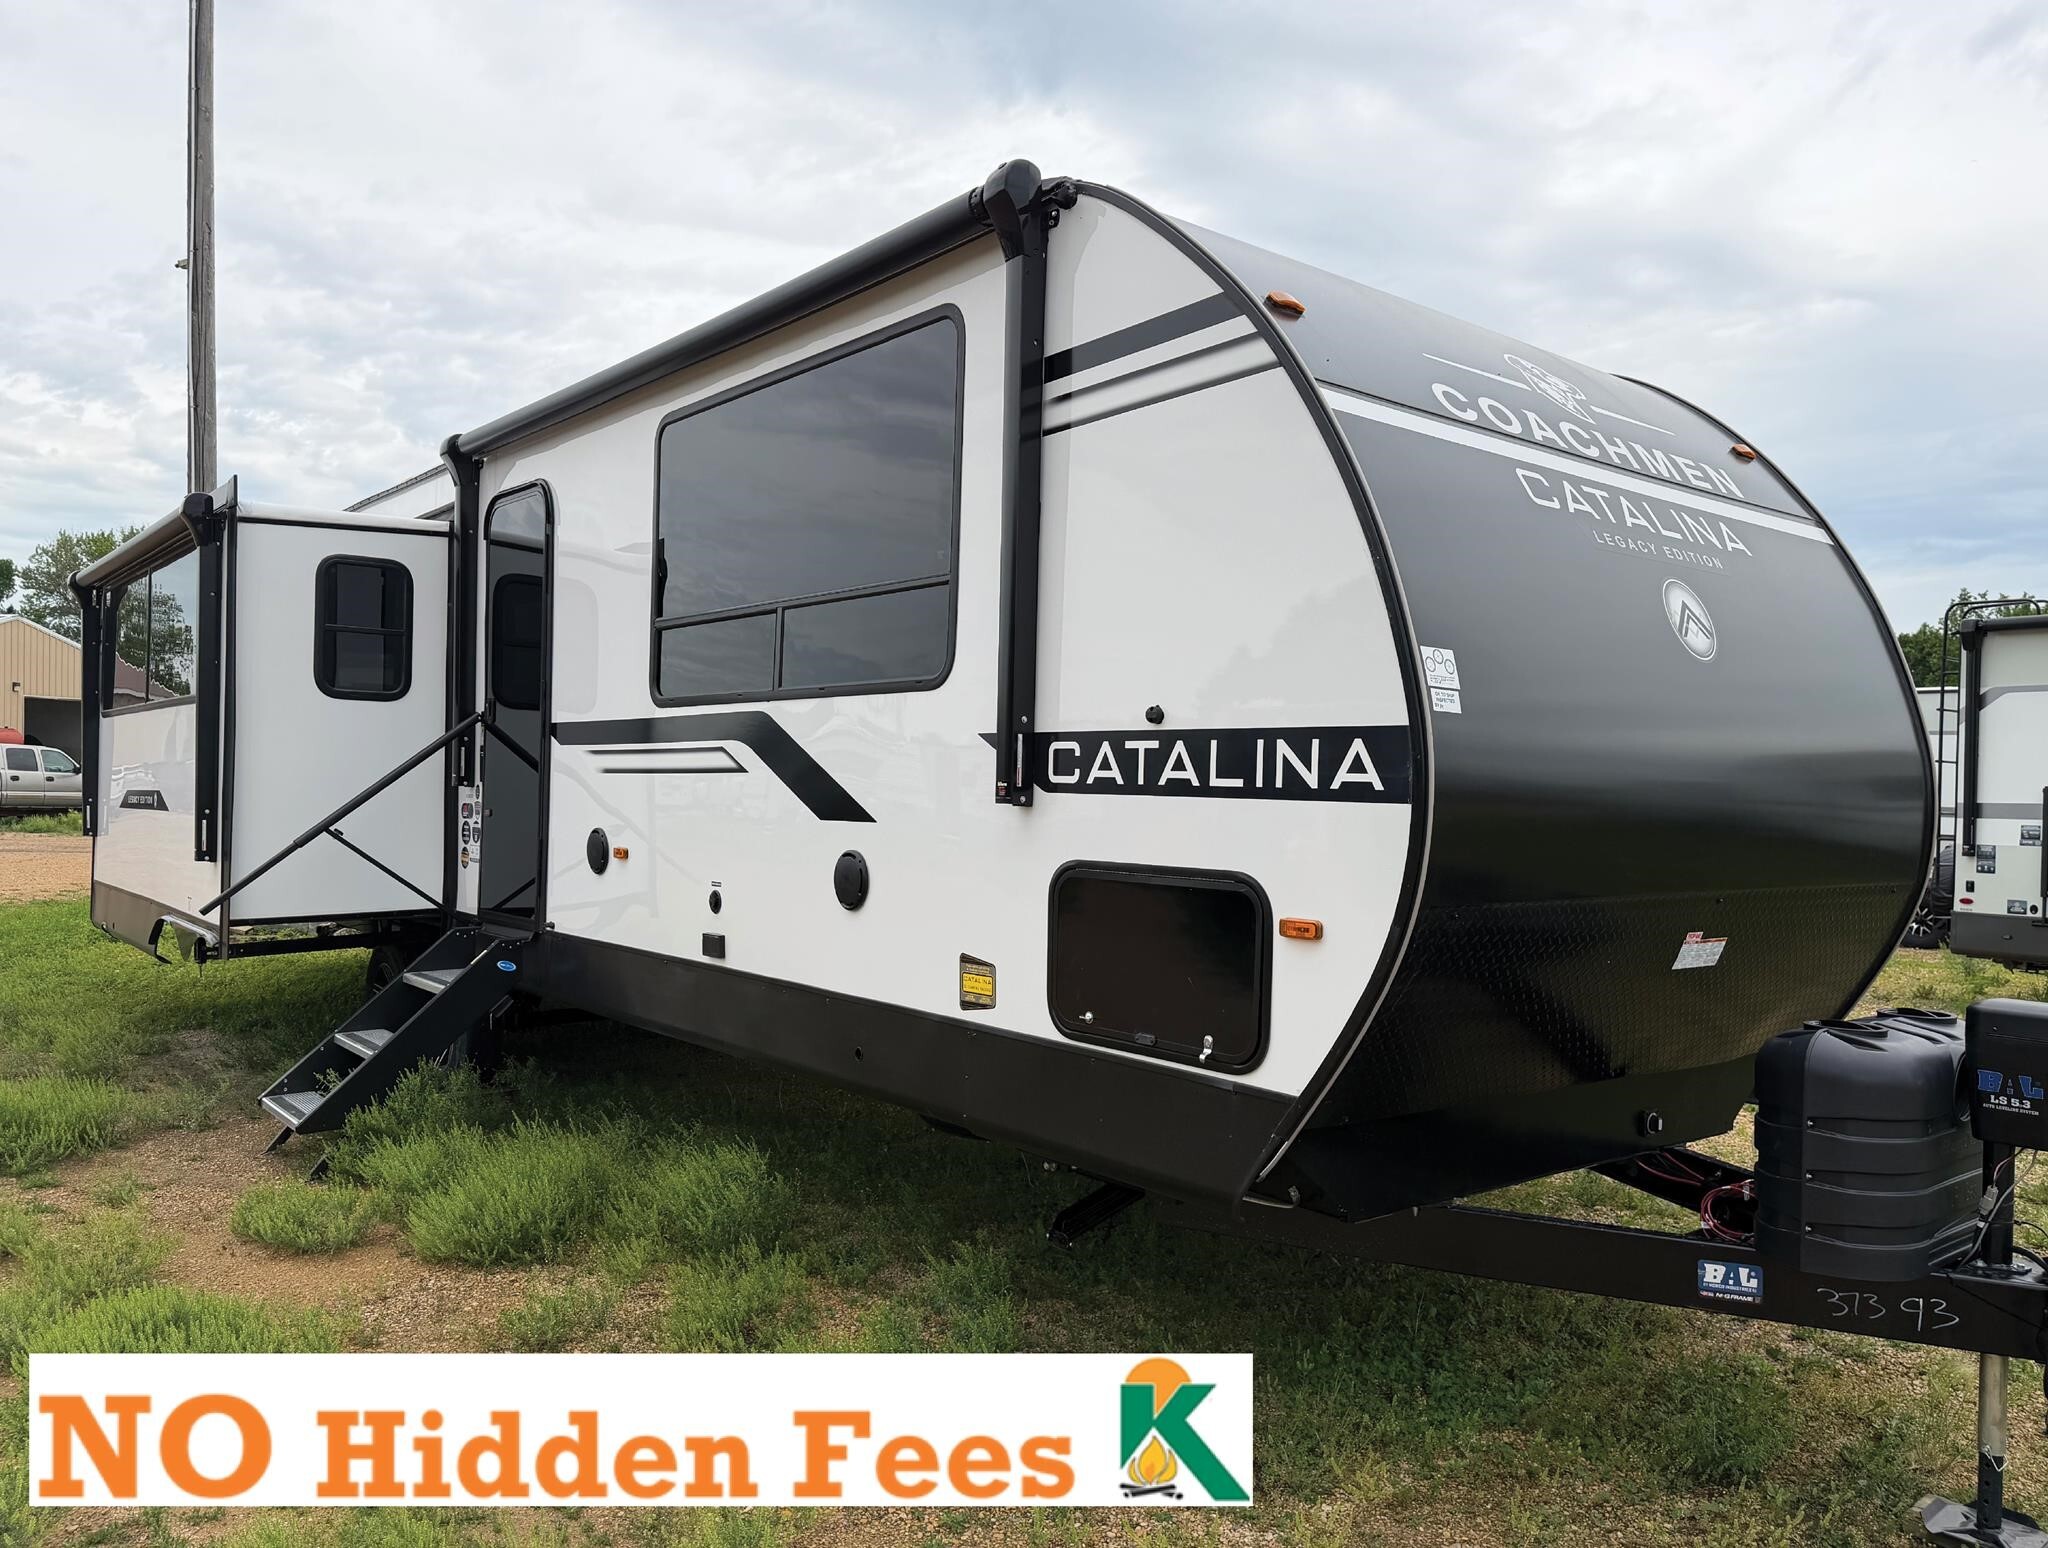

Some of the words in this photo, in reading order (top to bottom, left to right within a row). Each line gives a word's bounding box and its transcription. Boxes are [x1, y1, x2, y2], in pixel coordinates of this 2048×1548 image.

[1432, 382, 1745, 499] COACHMEN
[1515, 467, 1753, 557] CATALINA
[1593, 529, 1657, 555] LEGACY
[1662, 545, 1724, 569] EDITION
[1047, 737, 1385, 791] CATALINA
[1990, 1094, 2008, 1105] LS
[2011, 1098, 2031, 1109] 5.3
[1703, 1263, 1758, 1288] BAL
